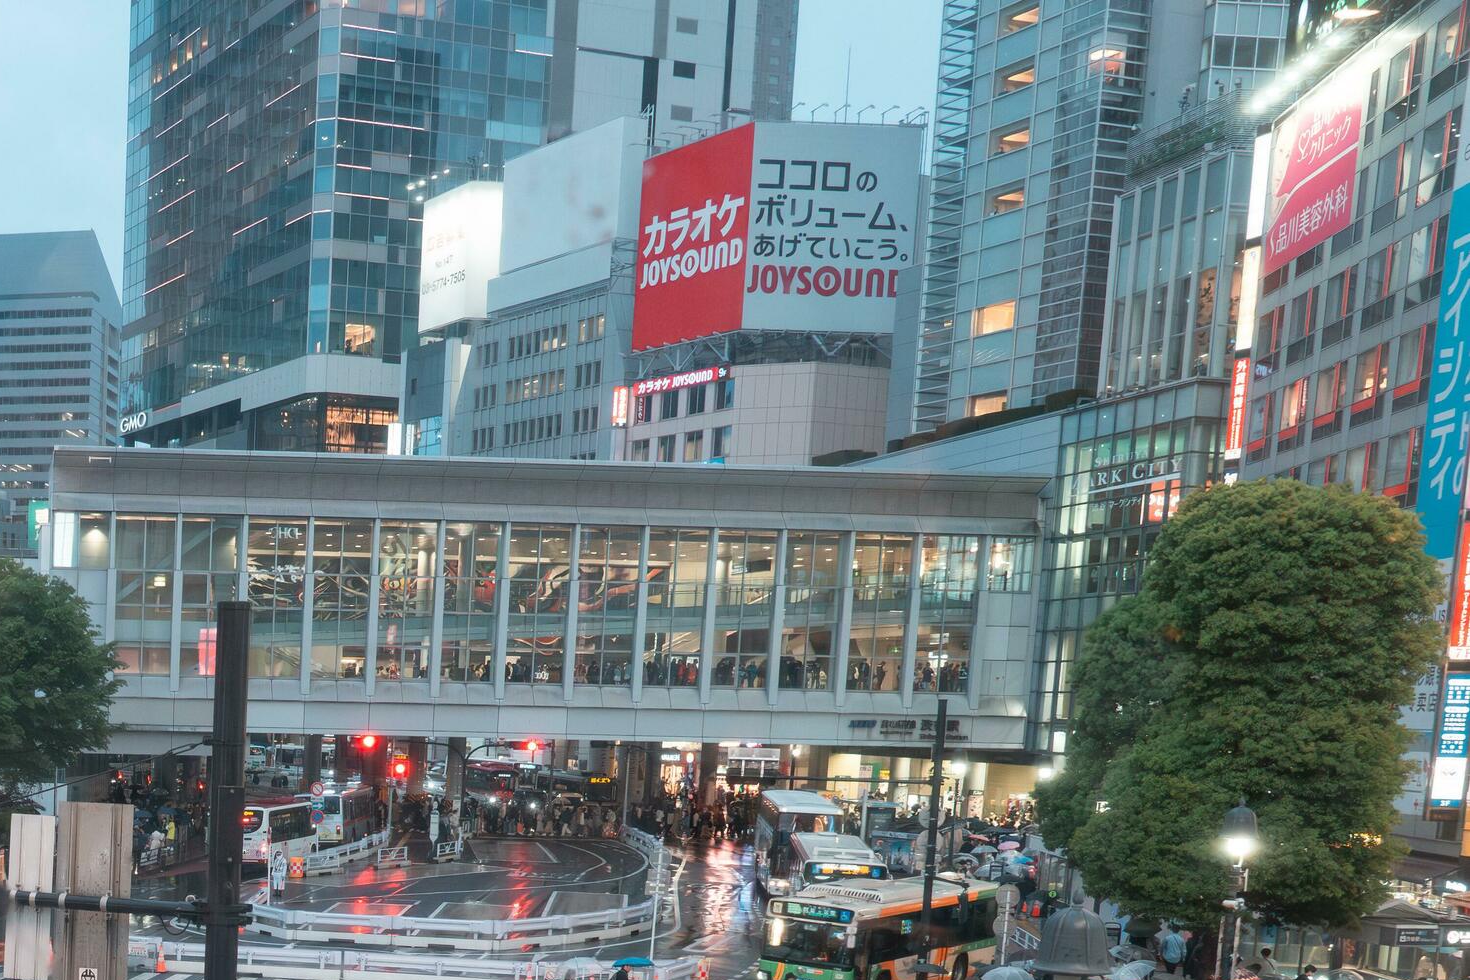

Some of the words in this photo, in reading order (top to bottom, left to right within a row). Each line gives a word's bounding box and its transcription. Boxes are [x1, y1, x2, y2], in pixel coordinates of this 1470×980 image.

[1308, 116, 1351, 165] クリニック
[758, 159, 878, 192] ココロの
[642, 194, 745, 258] カラオケ
[755, 194, 908, 232] ボリューム、
[1275, 180, 1349, 254] 品川美容外科
[640, 237, 744, 289] JOYSOUND
[753, 232, 909, 263] あげていこう。
[638, 378, 670, 394] カラオケ
[672, 369, 713, 388] JOYSOUND
[120, 412, 147, 432] GMO
[1132, 457, 1183, 480] CITY
